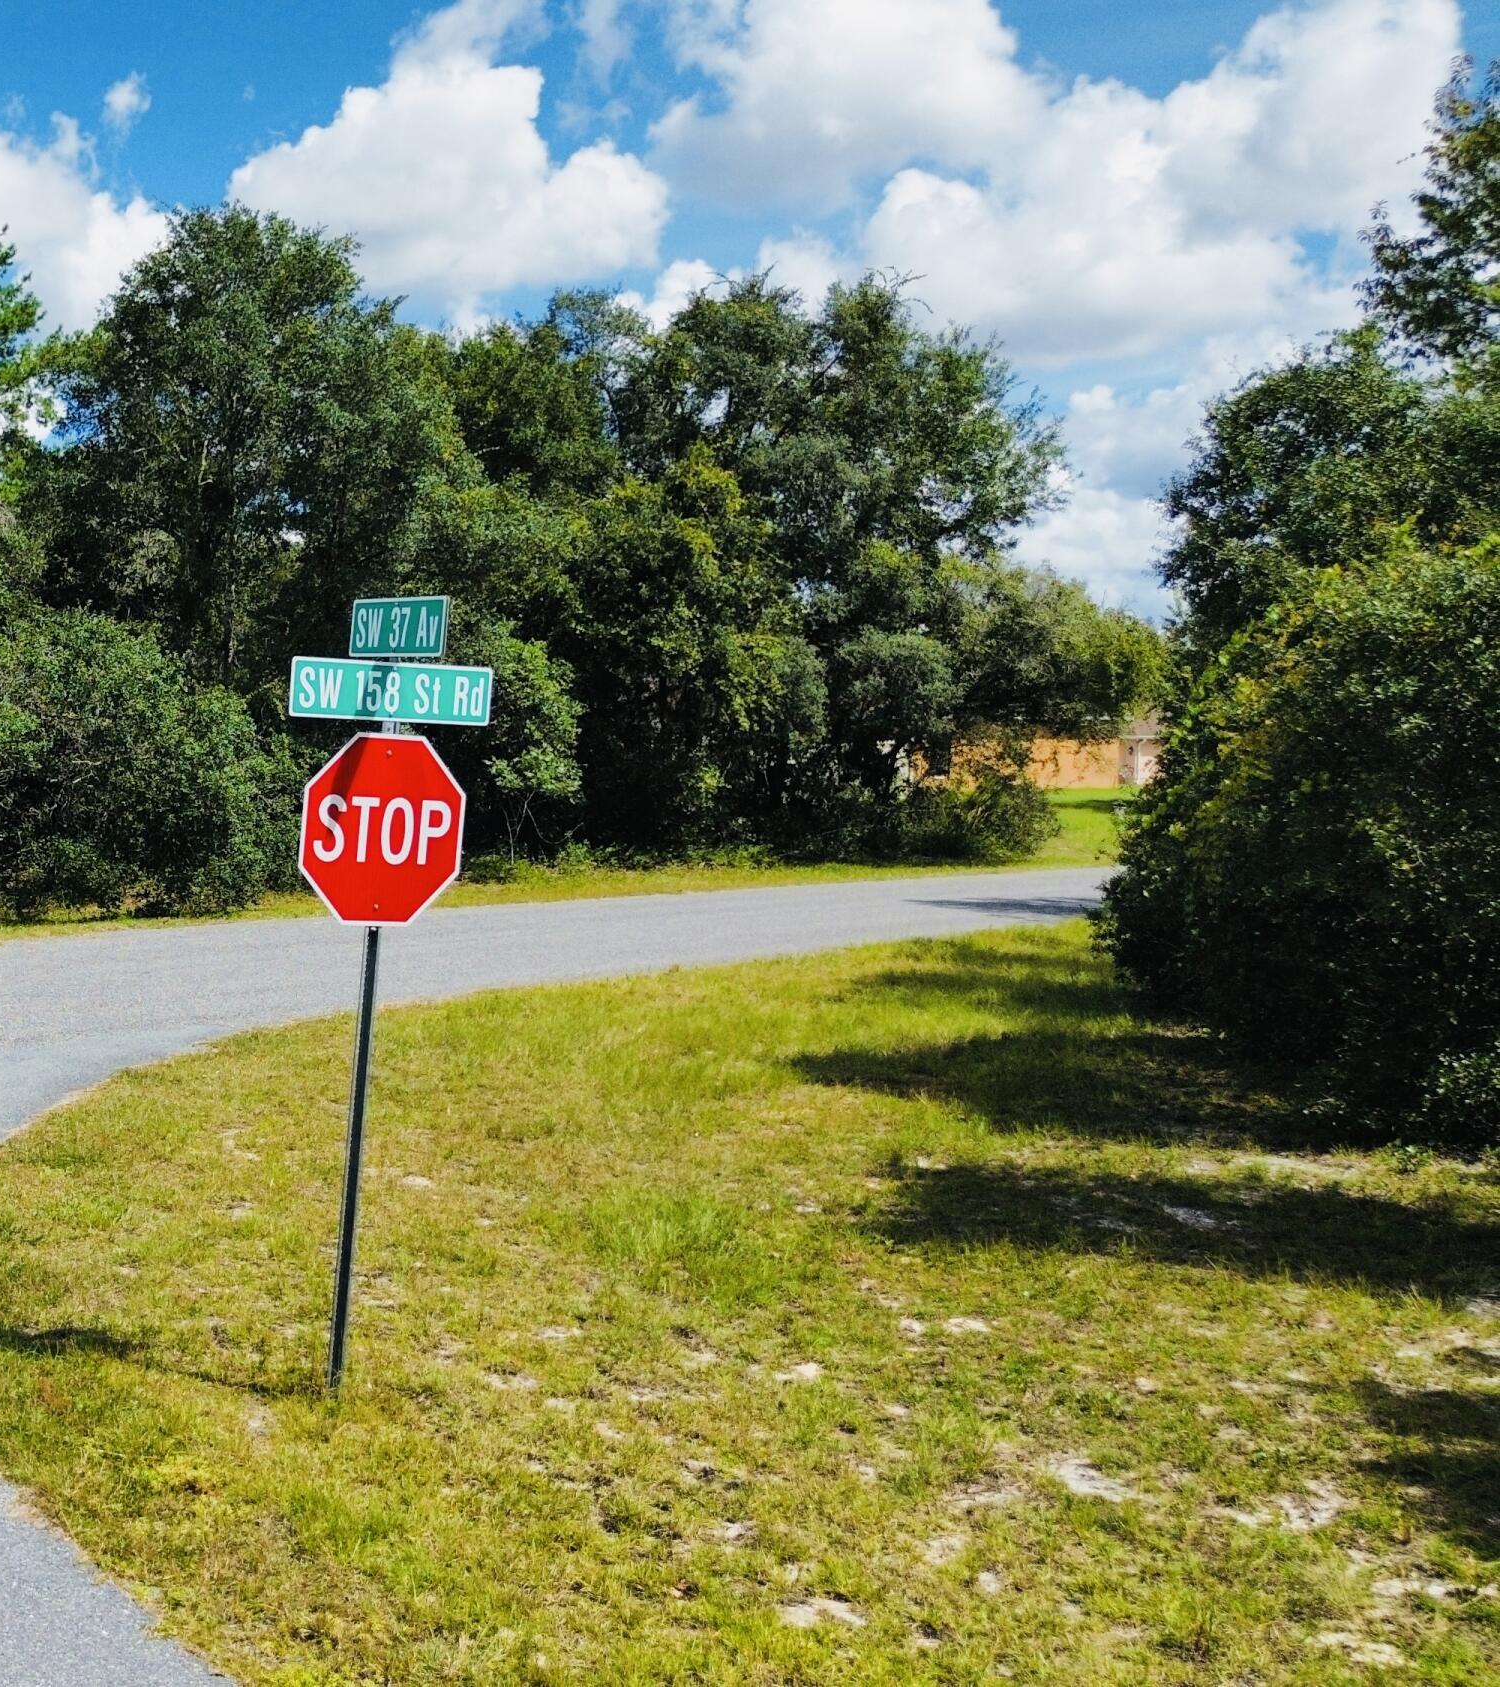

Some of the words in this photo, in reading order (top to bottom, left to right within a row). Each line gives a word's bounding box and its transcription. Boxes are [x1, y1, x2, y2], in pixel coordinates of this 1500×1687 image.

[355, 607, 384, 648] SW
[389, 606, 411, 648] 37
[415, 606, 439, 648] Av
[299, 666, 343, 709] SW
[355, 670, 401, 714] 158
[413, 673, 441, 715] St
[452, 676, 485, 717] Rd
[312, 793, 452, 866] STOP
